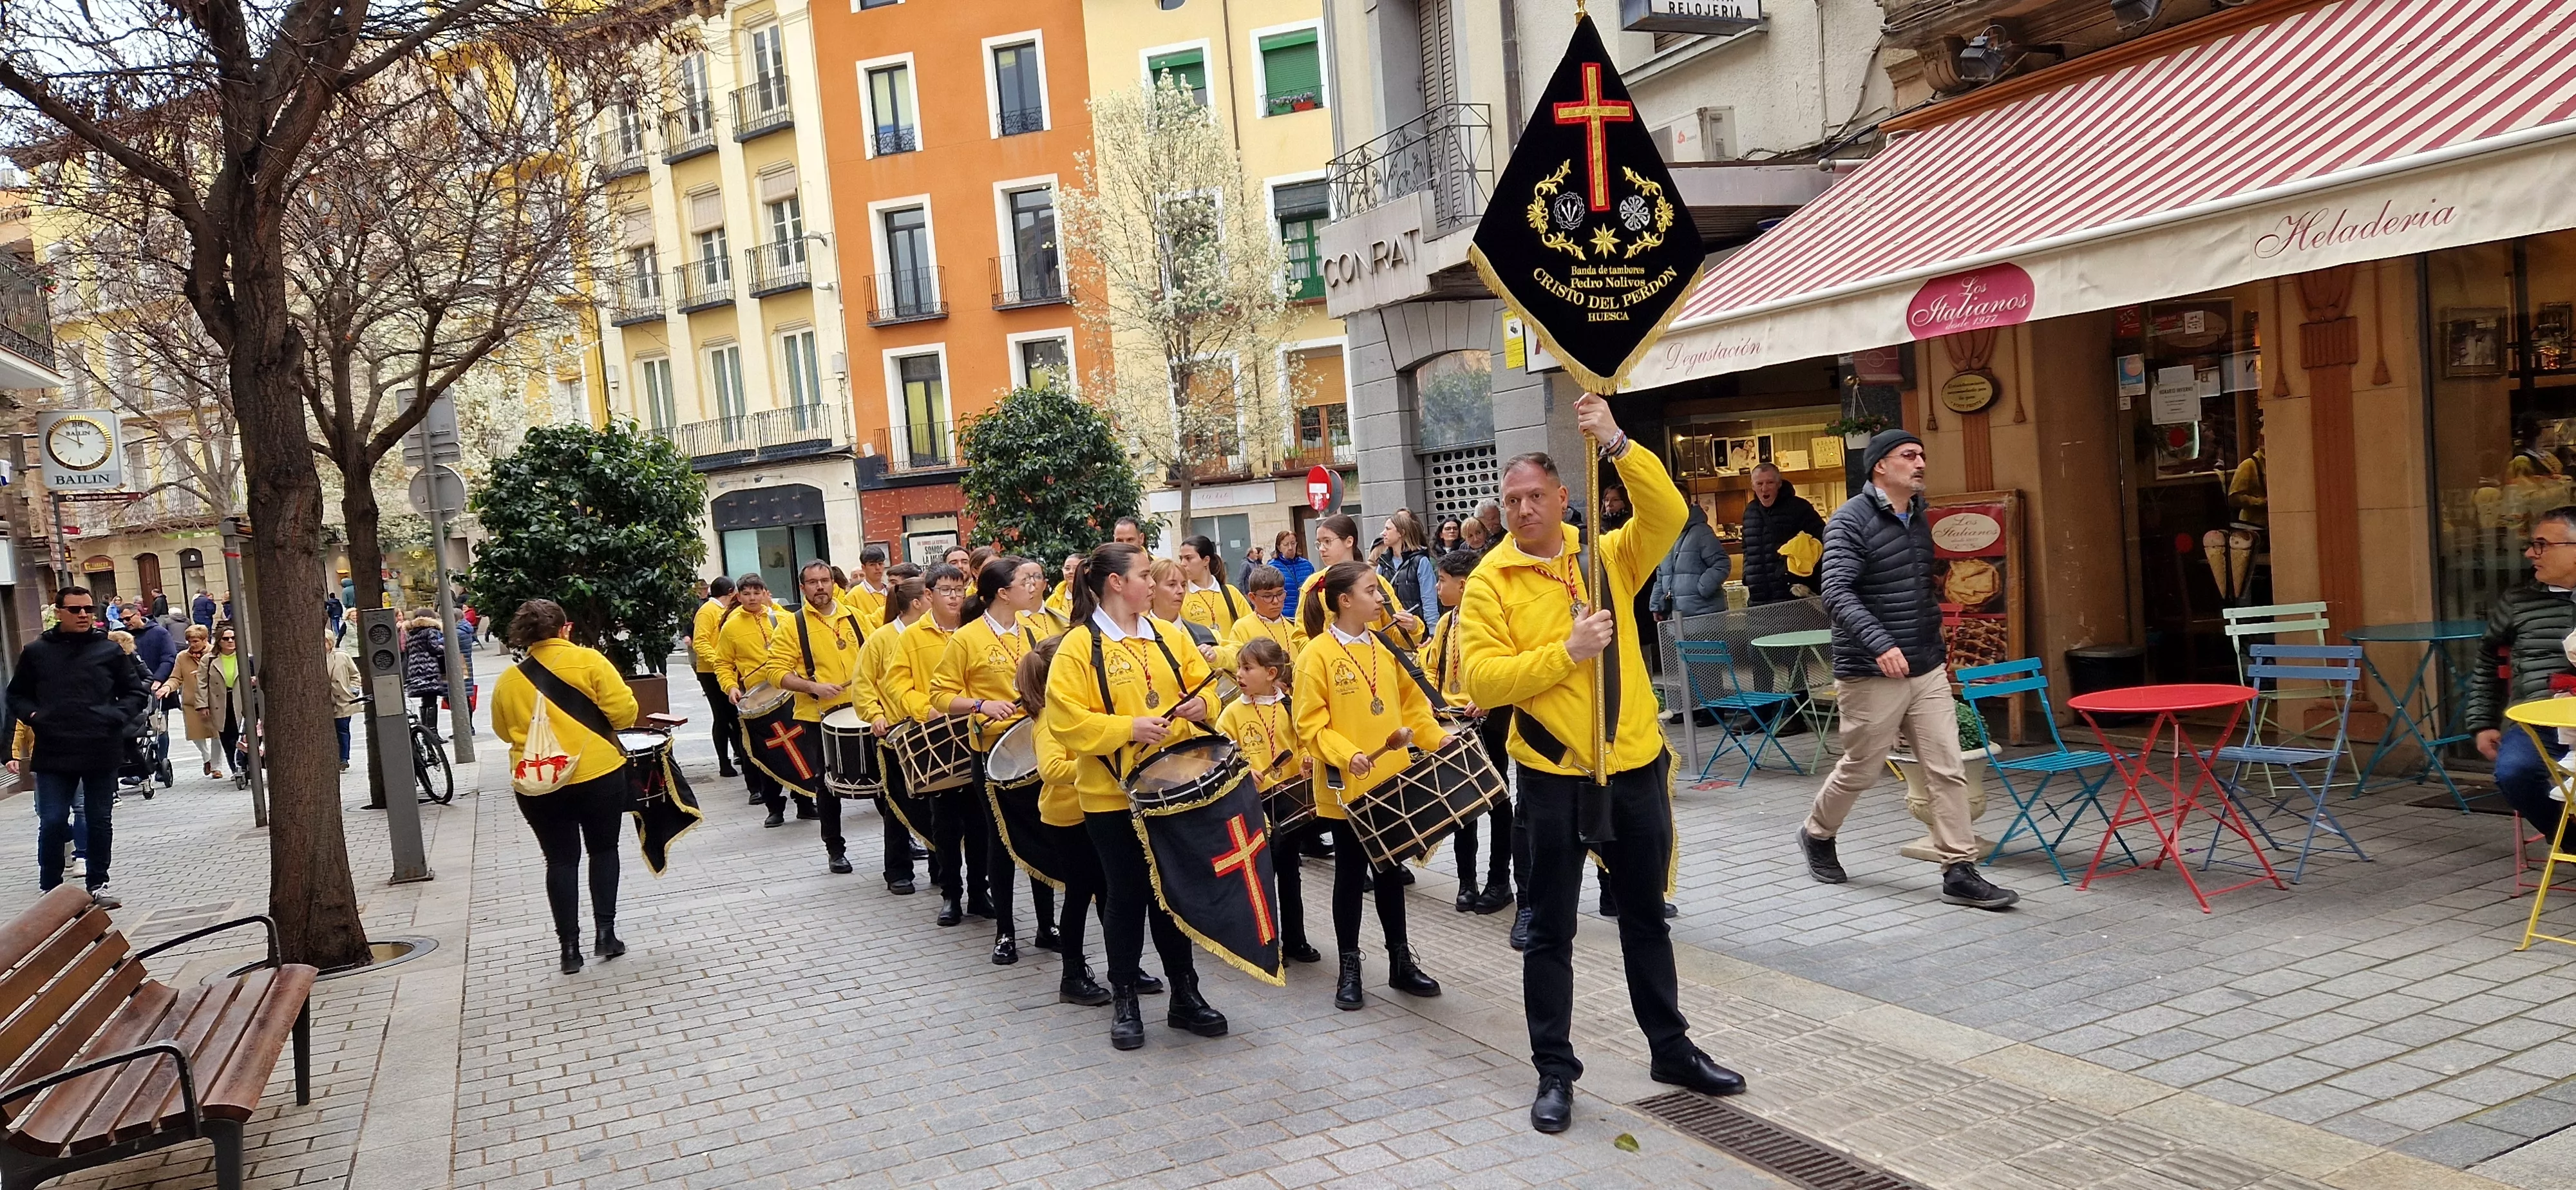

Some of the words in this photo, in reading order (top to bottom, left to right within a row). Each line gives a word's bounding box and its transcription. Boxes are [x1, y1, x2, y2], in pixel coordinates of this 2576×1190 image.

[1669, 1, 1743, 18] RELOJERIA
[2255, 198, 2457, 259] Heladeria
[1323, 227, 1420, 287] CONRAT
[1571, 265, 1596, 276] Banda
[1598, 265, 1608, 275] de
[1609, 265, 1645, 275] tambores
[1533, 267, 1584, 305] CRISTO
[1587, 295, 1620, 310] DEL
[1622, 265, 1678, 307] PERDON
[1570, 277, 1603, 288] Pedro
[1605, 276, 1645, 288] Nolivos
[1958, 276, 1987, 297] Los
[1588, 311, 1630, 322] HUESCA
[1912, 293, 2029, 327] Italianos
[1945, 318, 1968, 330] desde
[1973, 314, 1998, 326] 1977
[1665, 337, 1762, 377] Degustación
[54, 474, 111, 486] BAILIN
[1951, 515, 1978, 526] Los
[1934, 526, 1998, 538] Italianos
[924, 545, 943, 555] SOMOS
[922, 555, 929, 565] LA
